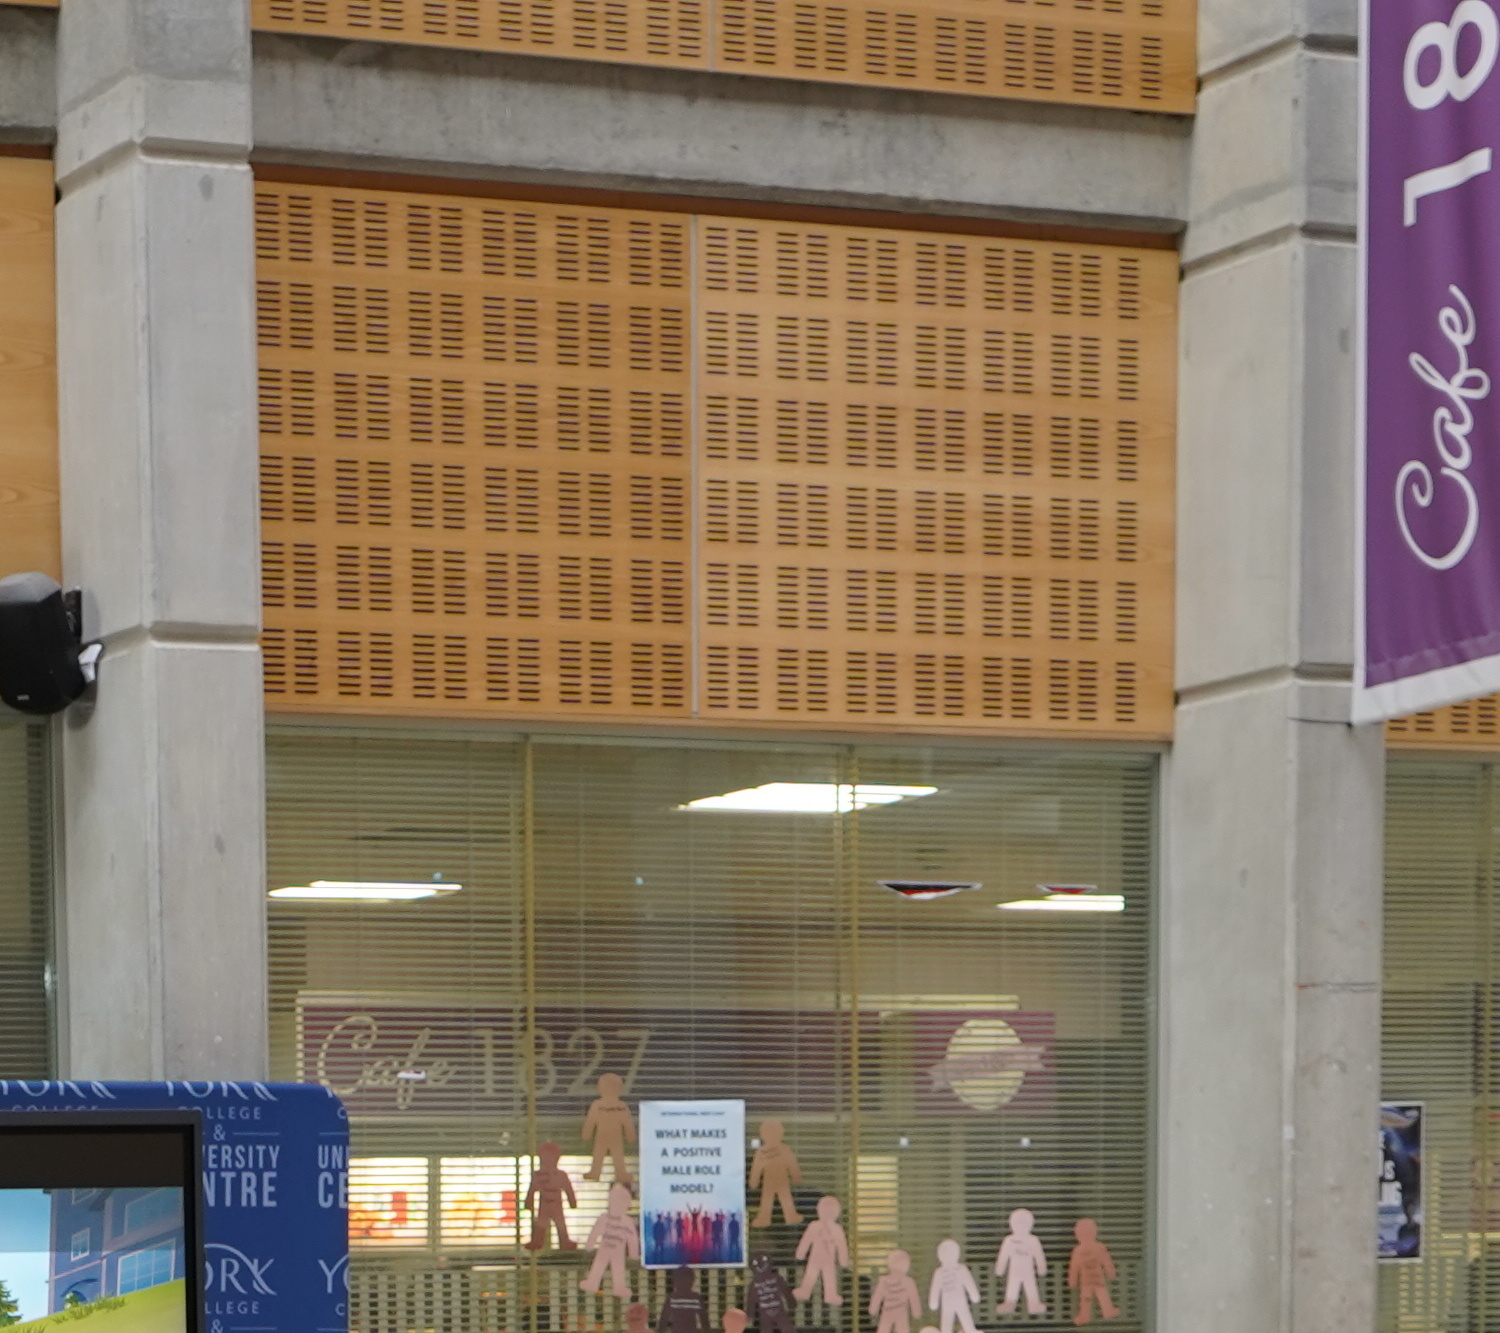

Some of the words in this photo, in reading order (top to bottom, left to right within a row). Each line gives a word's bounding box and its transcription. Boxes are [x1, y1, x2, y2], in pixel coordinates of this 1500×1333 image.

[1395, 283, 1491, 570] Cafe
[213, 1125, 226, 1141] &
[655, 1129, 688, 1139] WHAT
[691, 1129, 727, 1138] MAKES
[203, 1145, 280, 1168] ERSITY
[661, 1148, 669, 1157] A
[673, 1147, 722, 1157] POSITIVE
[662, 1165, 691, 1175] MALE
[694, 1165, 721, 1175] ROLE
[203, 1172, 277, 1207] NTRE
[670, 1184, 714, 1193] MODEL?
[205, 1302, 260, 1315] LLEGE
